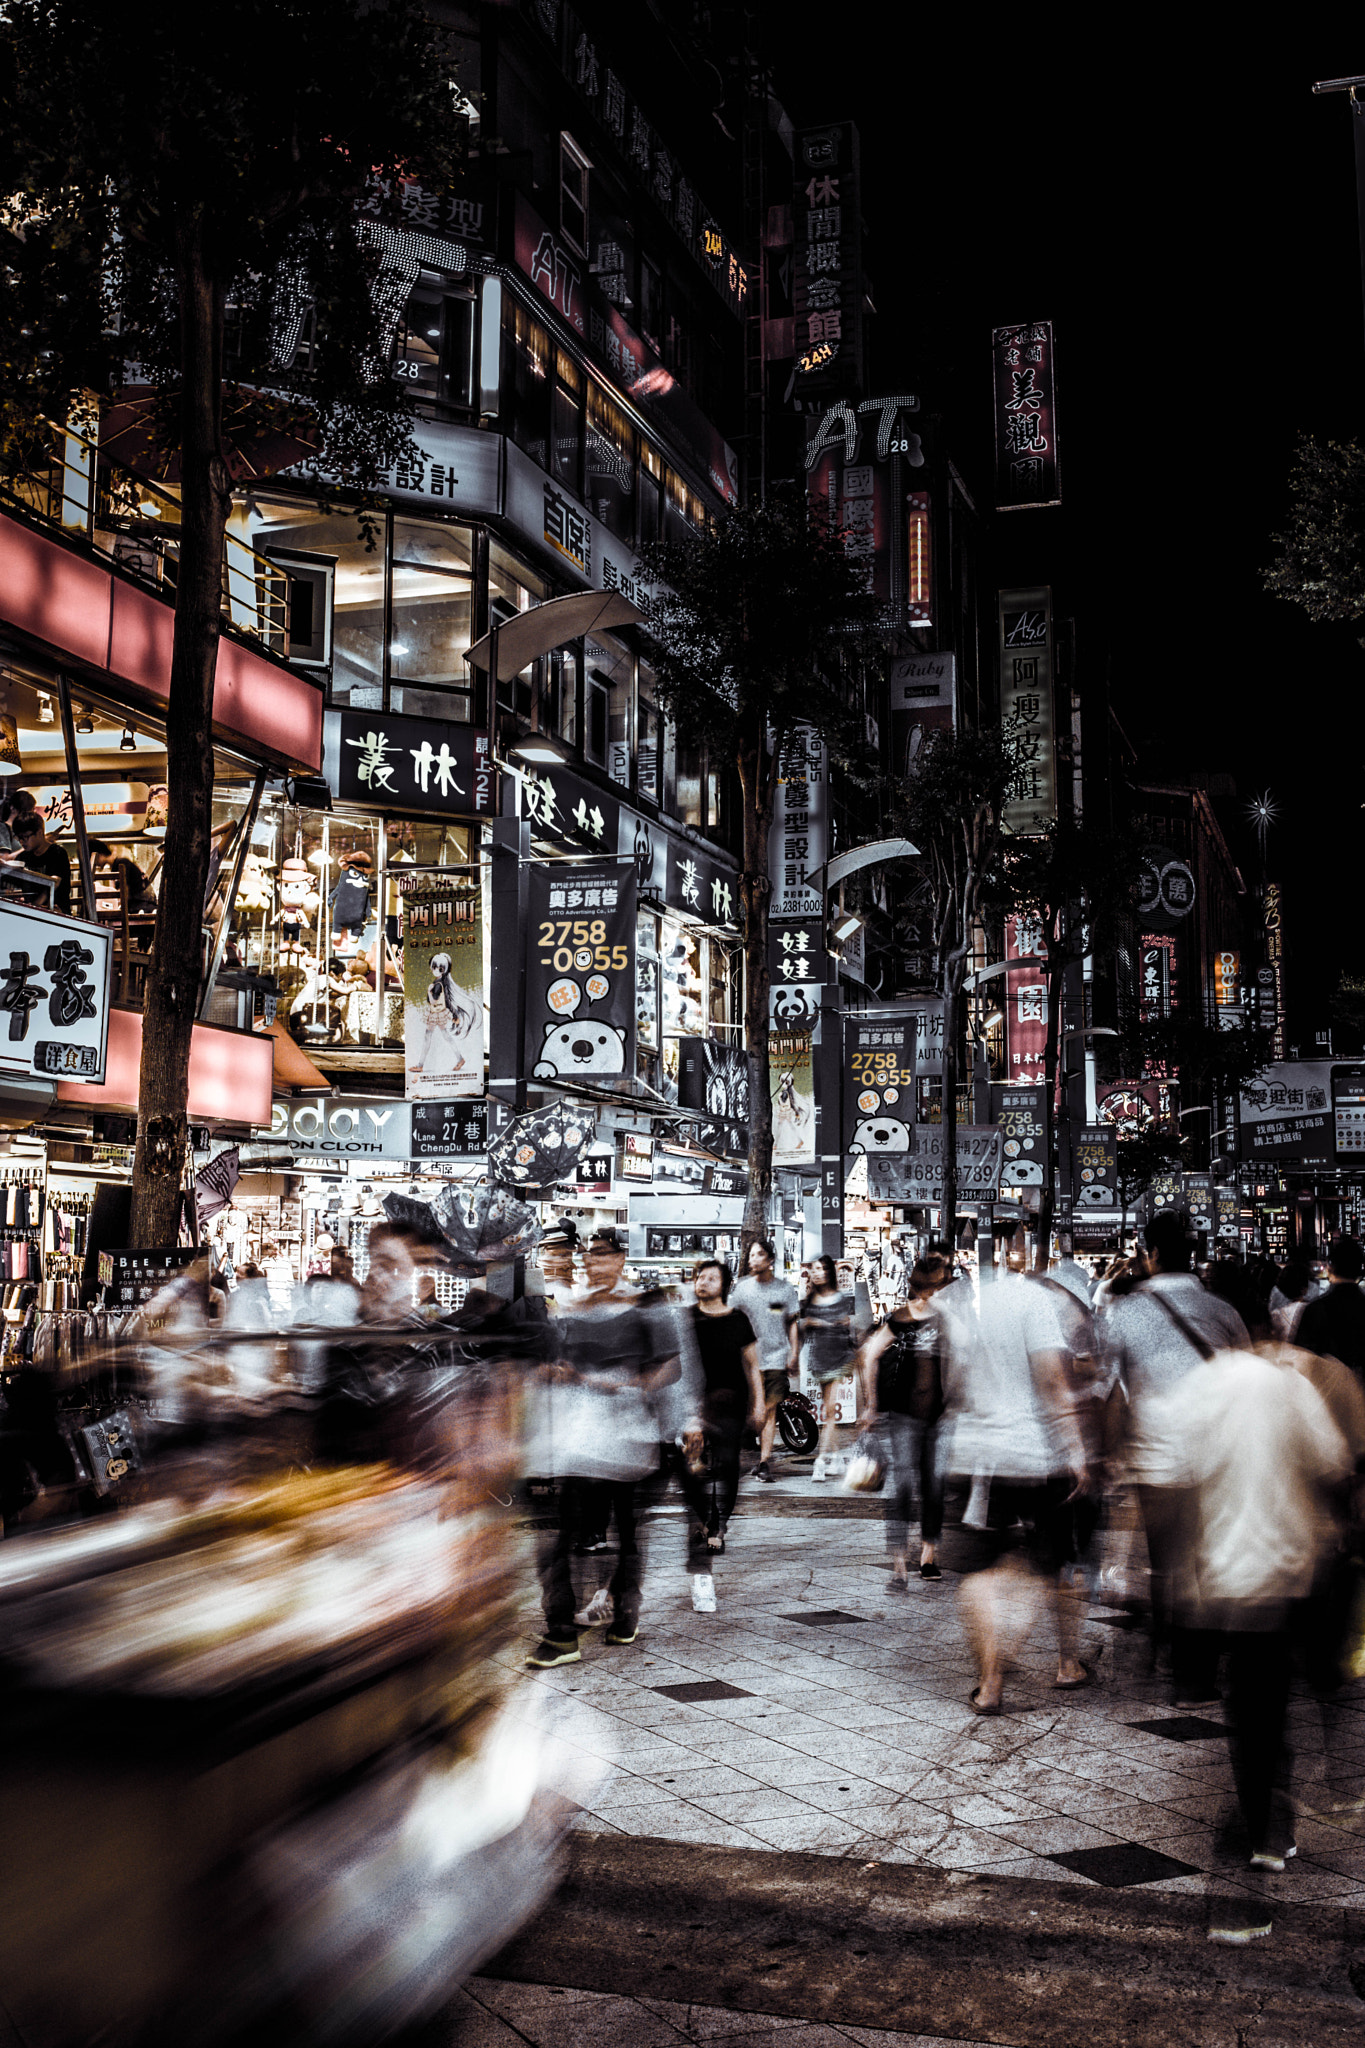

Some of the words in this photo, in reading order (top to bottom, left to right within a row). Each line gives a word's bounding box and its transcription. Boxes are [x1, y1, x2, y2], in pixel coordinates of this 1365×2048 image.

[805, 174, 842, 344] 休閒概念館
[800, 345, 833, 371] 24H
[397, 360, 419, 379] 28
[804, 394, 918, 470] AT
[890, 439, 909, 454] 28
[584, 518, 592, 578] SALON
[897, 662, 945, 679] Ruby
[1012, 657, 1043, 800] 阿瘦皮鞋
[345, 731, 466, 797] 叢林
[549, 888, 618, 909] 奧多廣告
[565, 908, 595, 916] Advertising
[538, 920, 607, 947] 2758
[776, 930, 817, 981] 娃娃
[588, 979, 607, 996] 旺!
[549, 984, 578, 1010] 旺!
[858, 1032, 905, 1045] 奧多廣告
[47, 1044, 95, 1074] 洋食屋
[850, 1053, 898, 1070] 2758
[916, 1048, 943, 1060] AUTY
[858, 1094, 879, 1111] 旺!
[416, 1105, 483, 1119] 成都路
[496, 1104, 509, 1126] E
[998, 1112, 1033, 1125] 2758
[417, 1132, 436, 1142] Lane
[442, 1122, 459, 1141] 27
[464, 1121, 481, 1140] 巷
[1003, 1124, 1044, 1137] 0055
[320, 1141, 383, 1153] CLOTH
[420, 1143, 462, 1154] ChengDu
[468, 1142, 483, 1152] Rd.
[1076, 1146, 1105, 1156] 2758
[826, 1172, 835, 1186] E
[1186, 1189, 1206, 1197] 2758
[823, 1197, 839, 1209] 26
[978, 1217, 991, 1227] 28
[119, 1257, 149, 1268] BEE
